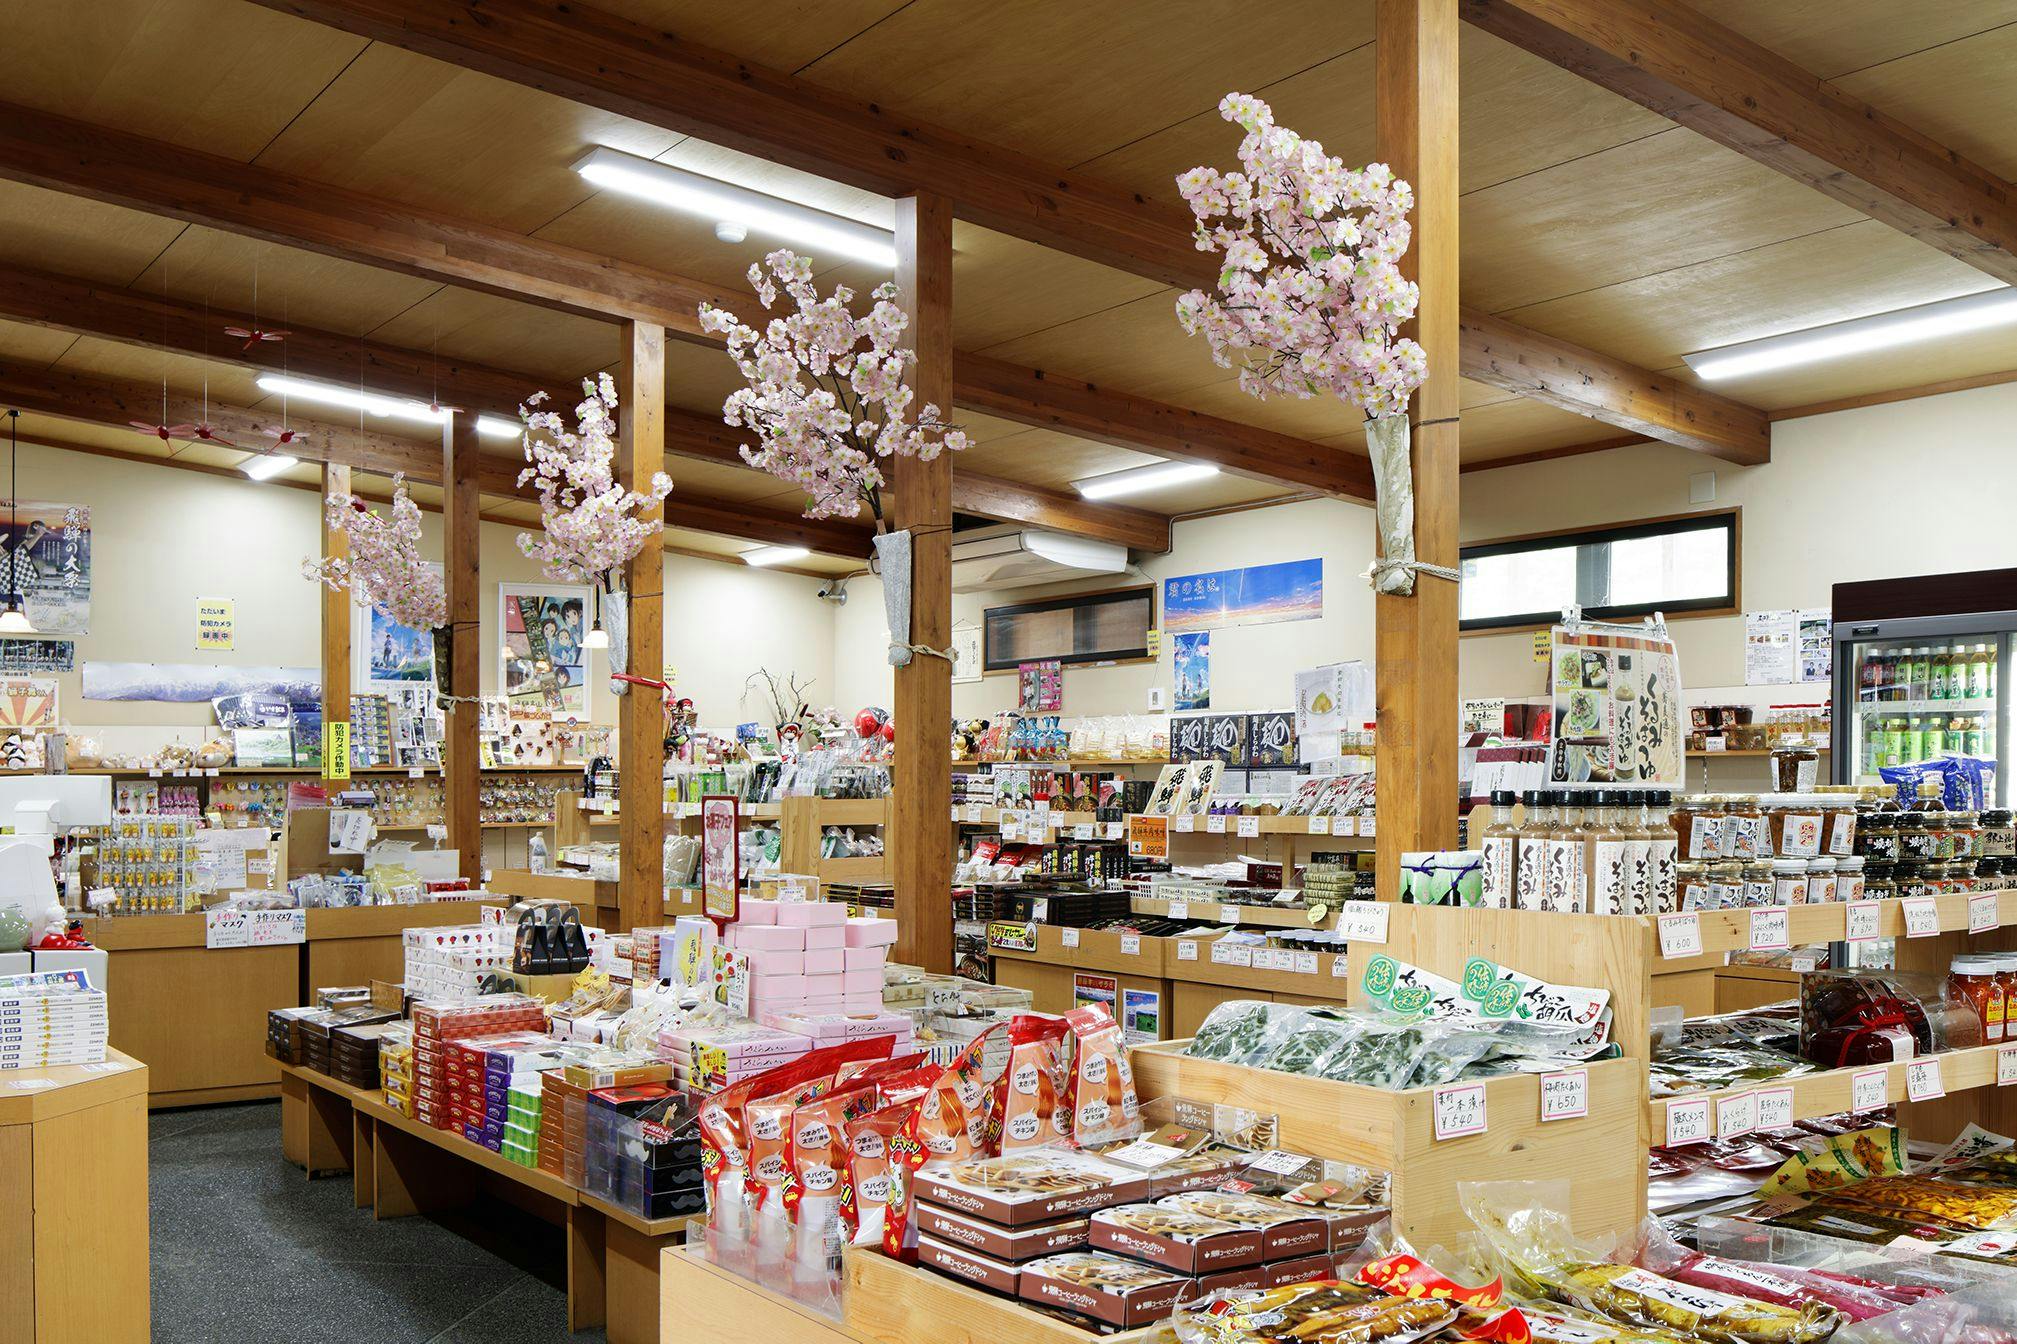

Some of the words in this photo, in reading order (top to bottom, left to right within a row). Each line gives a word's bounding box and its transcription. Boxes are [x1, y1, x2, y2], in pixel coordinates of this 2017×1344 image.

[1647, 673, 1662, 748] くるみ
[1636, 695, 1656, 780] そばつゆ
[335, 723, 344, 774] 防犯カメラ作動中
[1483, 844, 1495, 893] くるみ
[1522, 845, 1537, 895] くるみ
[1553, 847, 1567, 898] くるみ
[1655, 859, 1674, 913] そばつゆ
[256, 912, 292, 922] 手作りマスク
[1083, 1106, 1107, 1114] スパイシー
[1547, 1095, 1577, 1111] ¥650
[1442, 1113, 1473, 1129] ¥540
[1723, 1118, 1747, 1133] ¥540
[1673, 1124, 1696, 1138] ¥540
[759, 1160, 781, 1170] スパイシ
[806, 1170, 832, 1178] スパイシー
